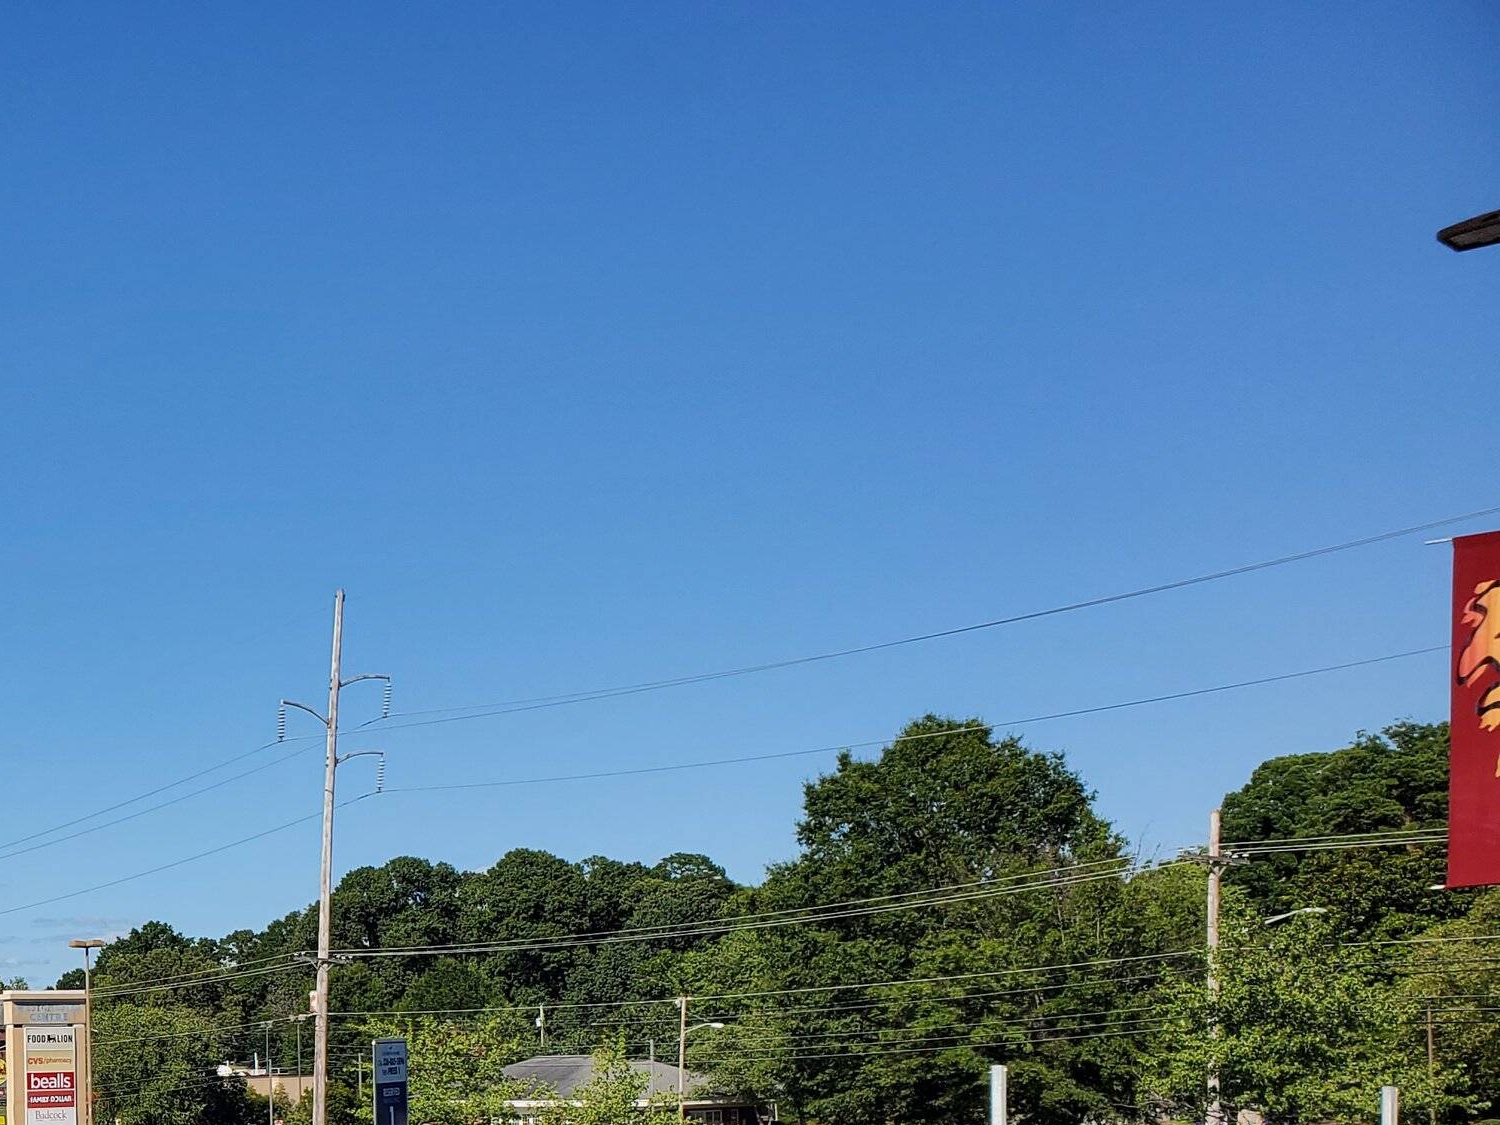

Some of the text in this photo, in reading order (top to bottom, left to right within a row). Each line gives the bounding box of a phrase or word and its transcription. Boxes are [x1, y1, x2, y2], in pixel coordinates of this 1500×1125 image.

[27, 1034, 73, 1043] FOOD LION
[30, 1073, 71, 1089] bealls
[35, 1110, 67, 1120] Badcock
